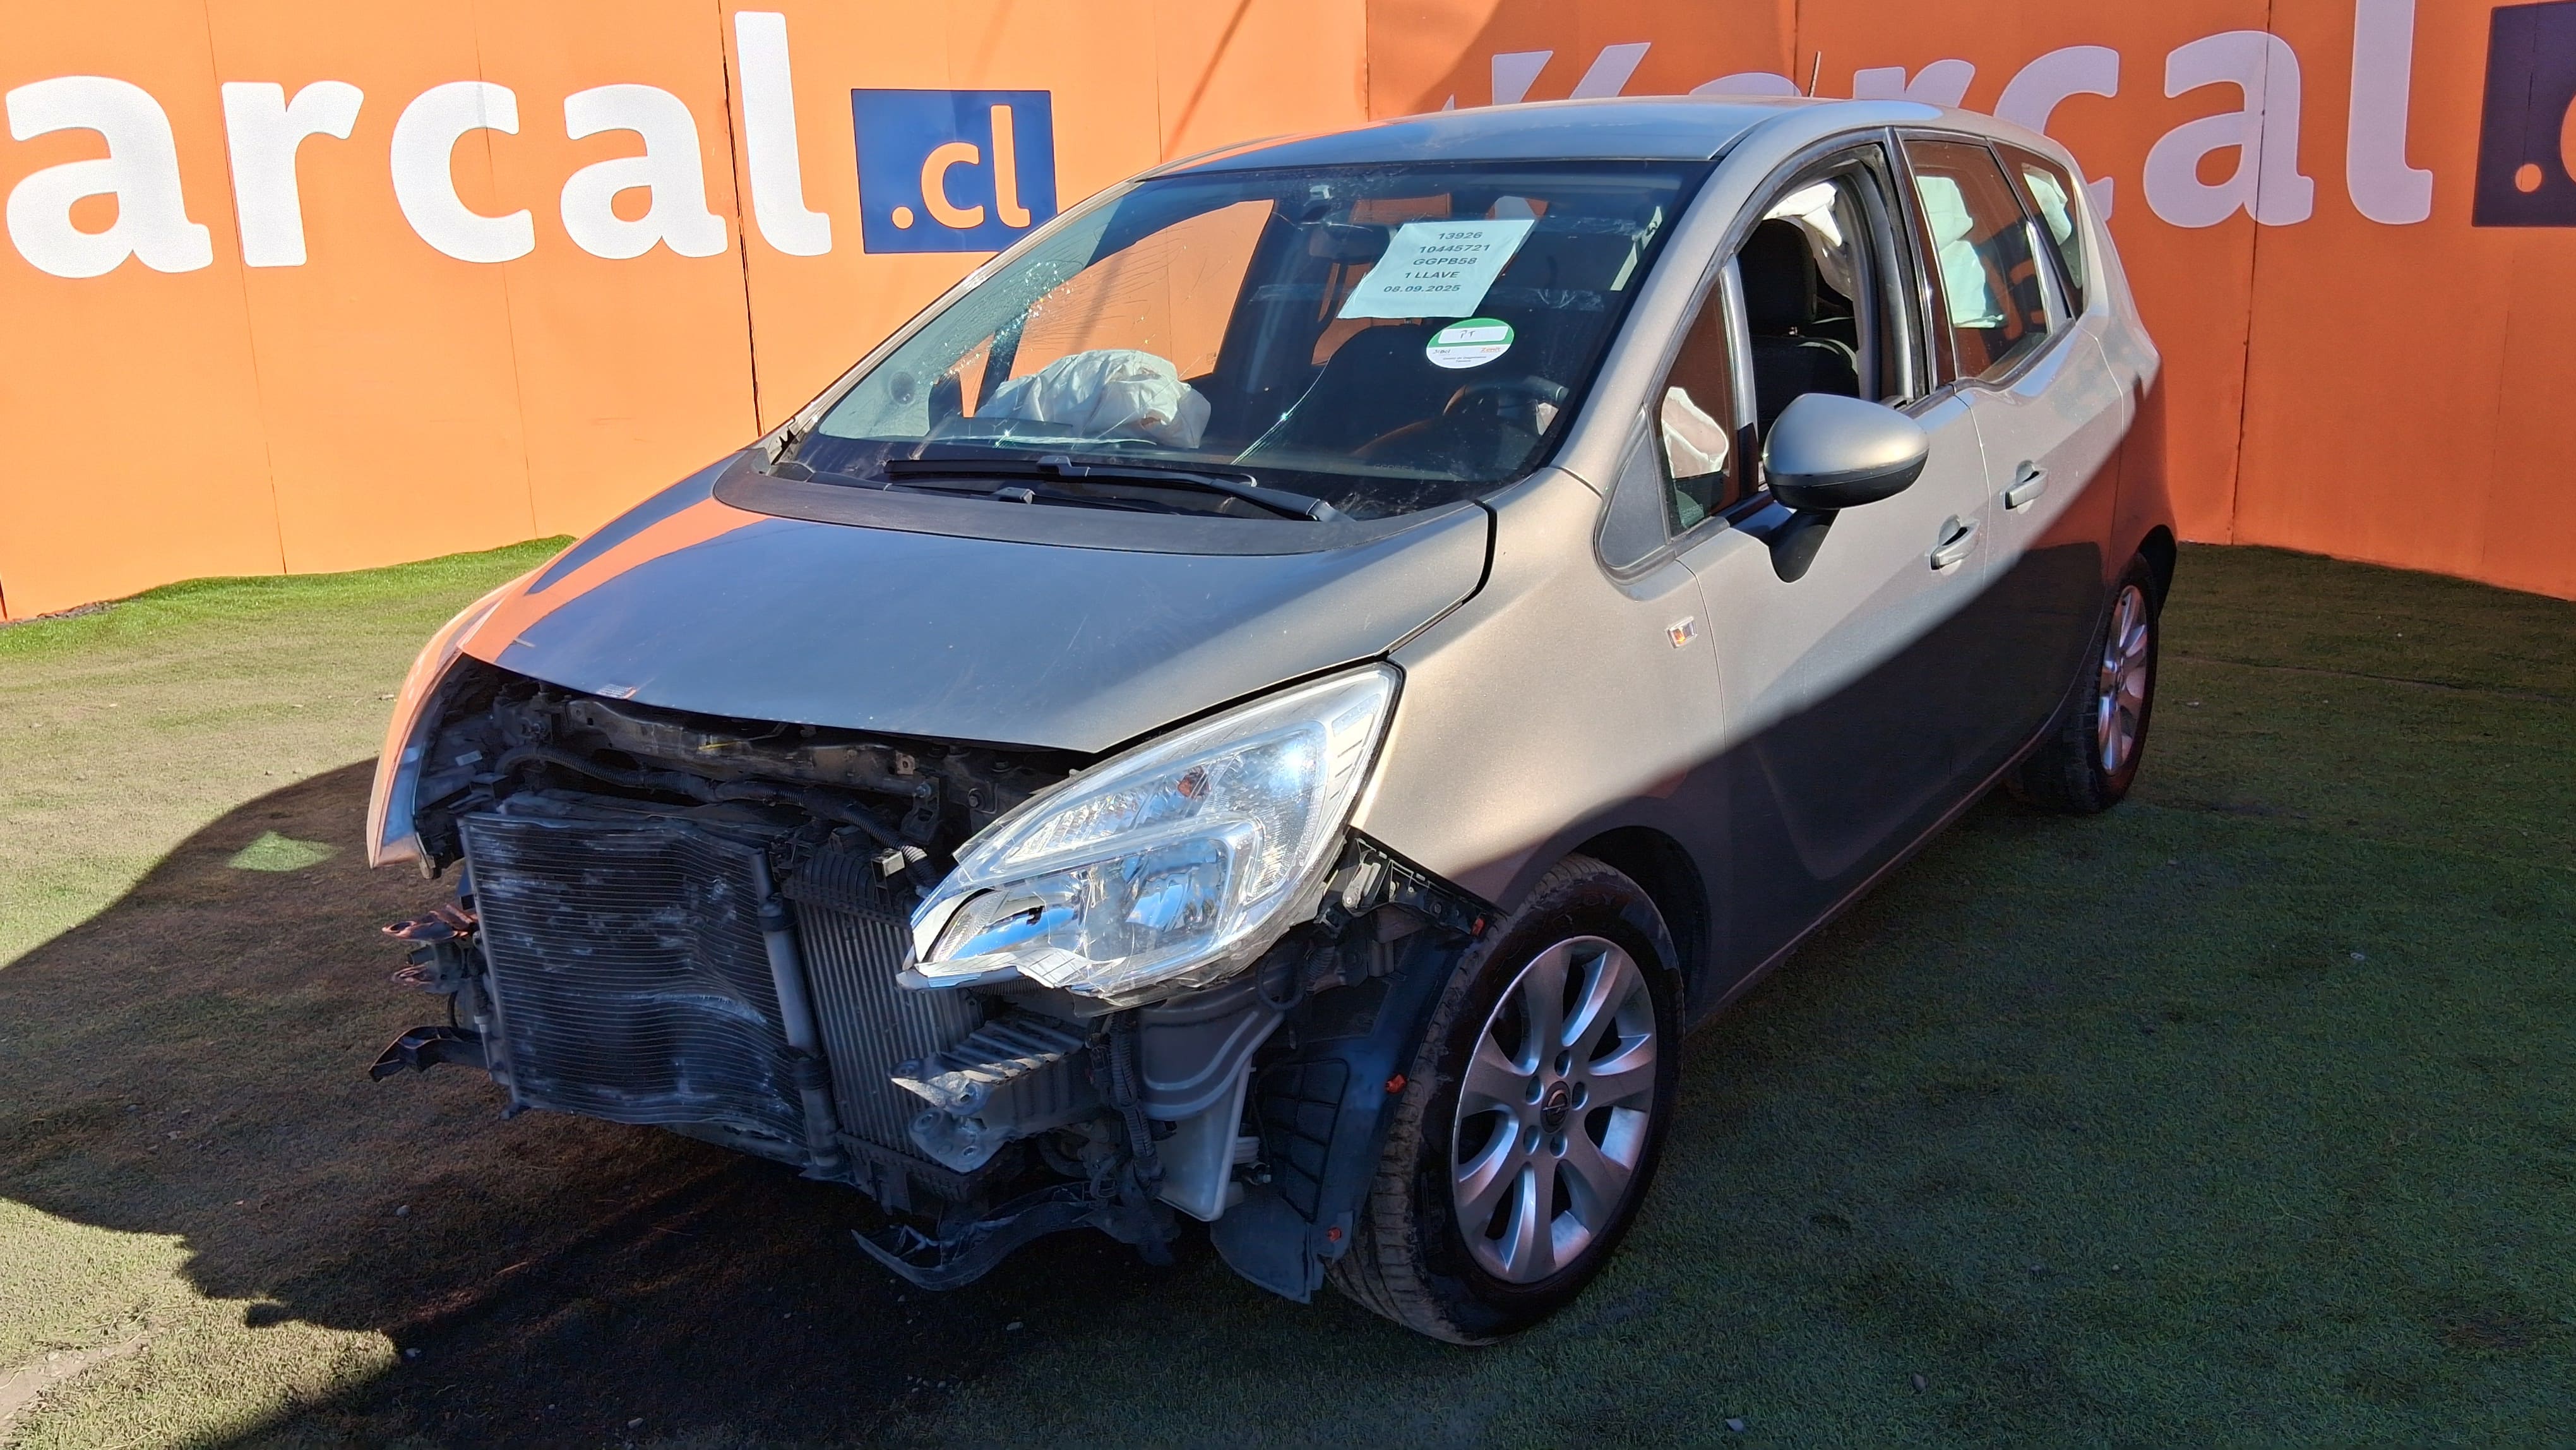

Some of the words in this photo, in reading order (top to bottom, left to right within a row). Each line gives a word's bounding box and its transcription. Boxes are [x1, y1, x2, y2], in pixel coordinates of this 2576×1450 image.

[891, 104, 1032, 230] .cl
[1438, 232, 1483, 240] 13926
[1419, 244, 1491, 253] 10445721
[1412, 257, 1478, 266] GGPB58
[1383, 284, 1462, 293] 08.09.2025
